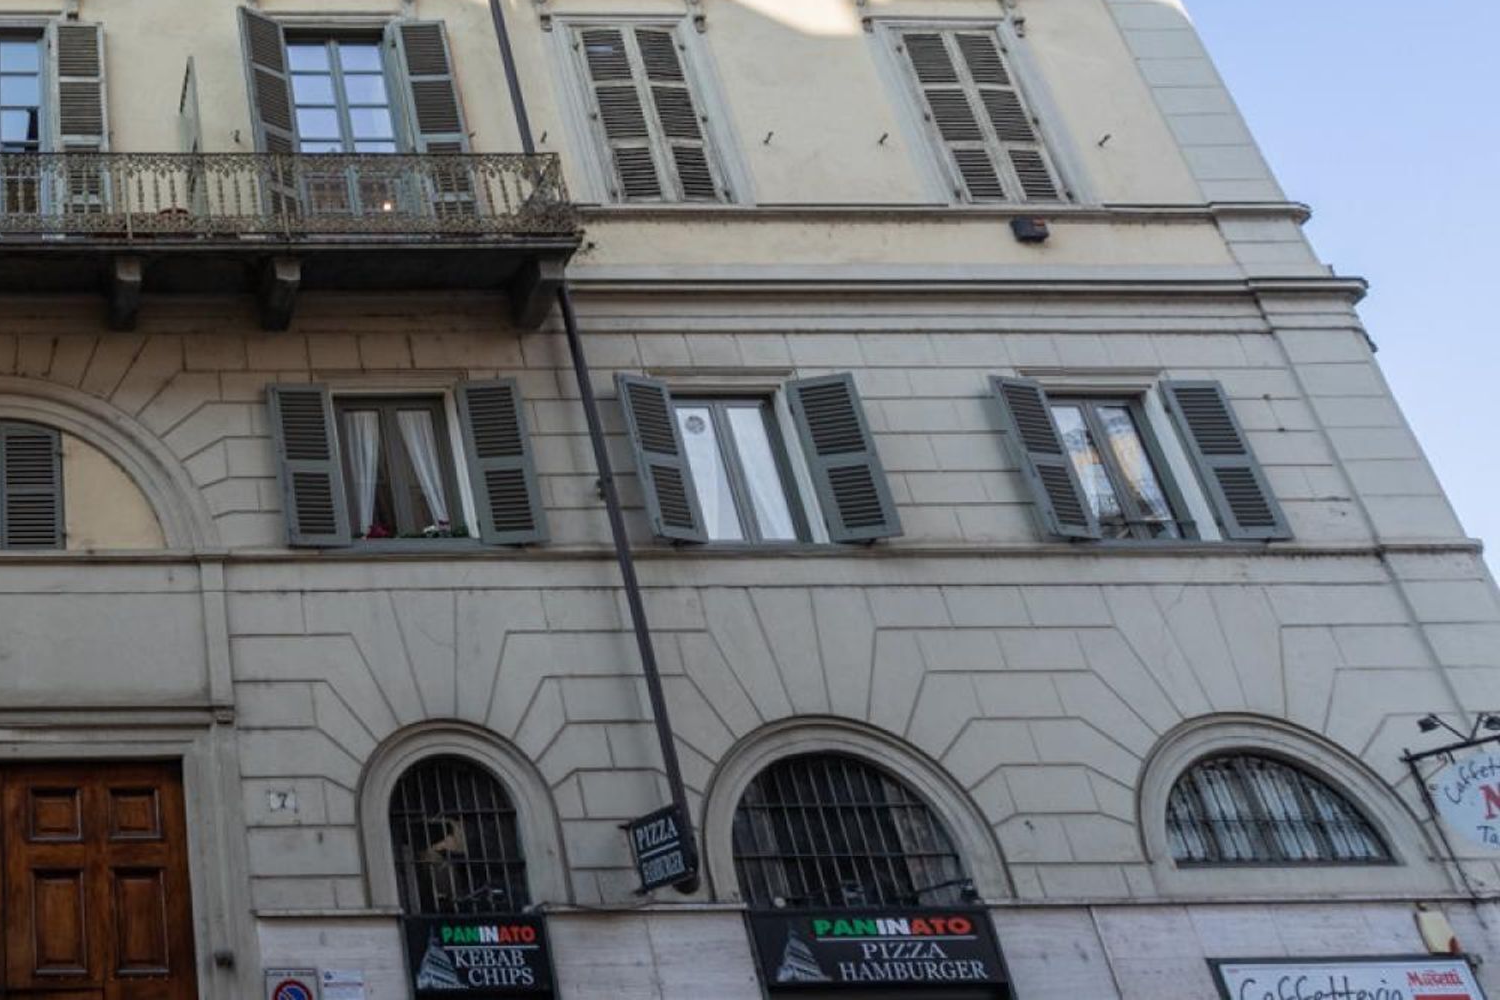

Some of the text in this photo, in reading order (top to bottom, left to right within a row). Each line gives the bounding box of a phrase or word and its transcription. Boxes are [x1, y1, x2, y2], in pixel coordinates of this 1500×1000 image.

[277, 791, 288, 810] 7
[635, 815, 679, 851] PIZZA
[441, 925, 536, 943] PANINATO
[813, 917, 973, 936] PANINATO
[453, 949, 526, 968] KEBAB
[861, 941, 948, 960] PIZZA
[468, 966, 535, 987] CHIPS
[838, 960, 989, 982] HAMBURGER
